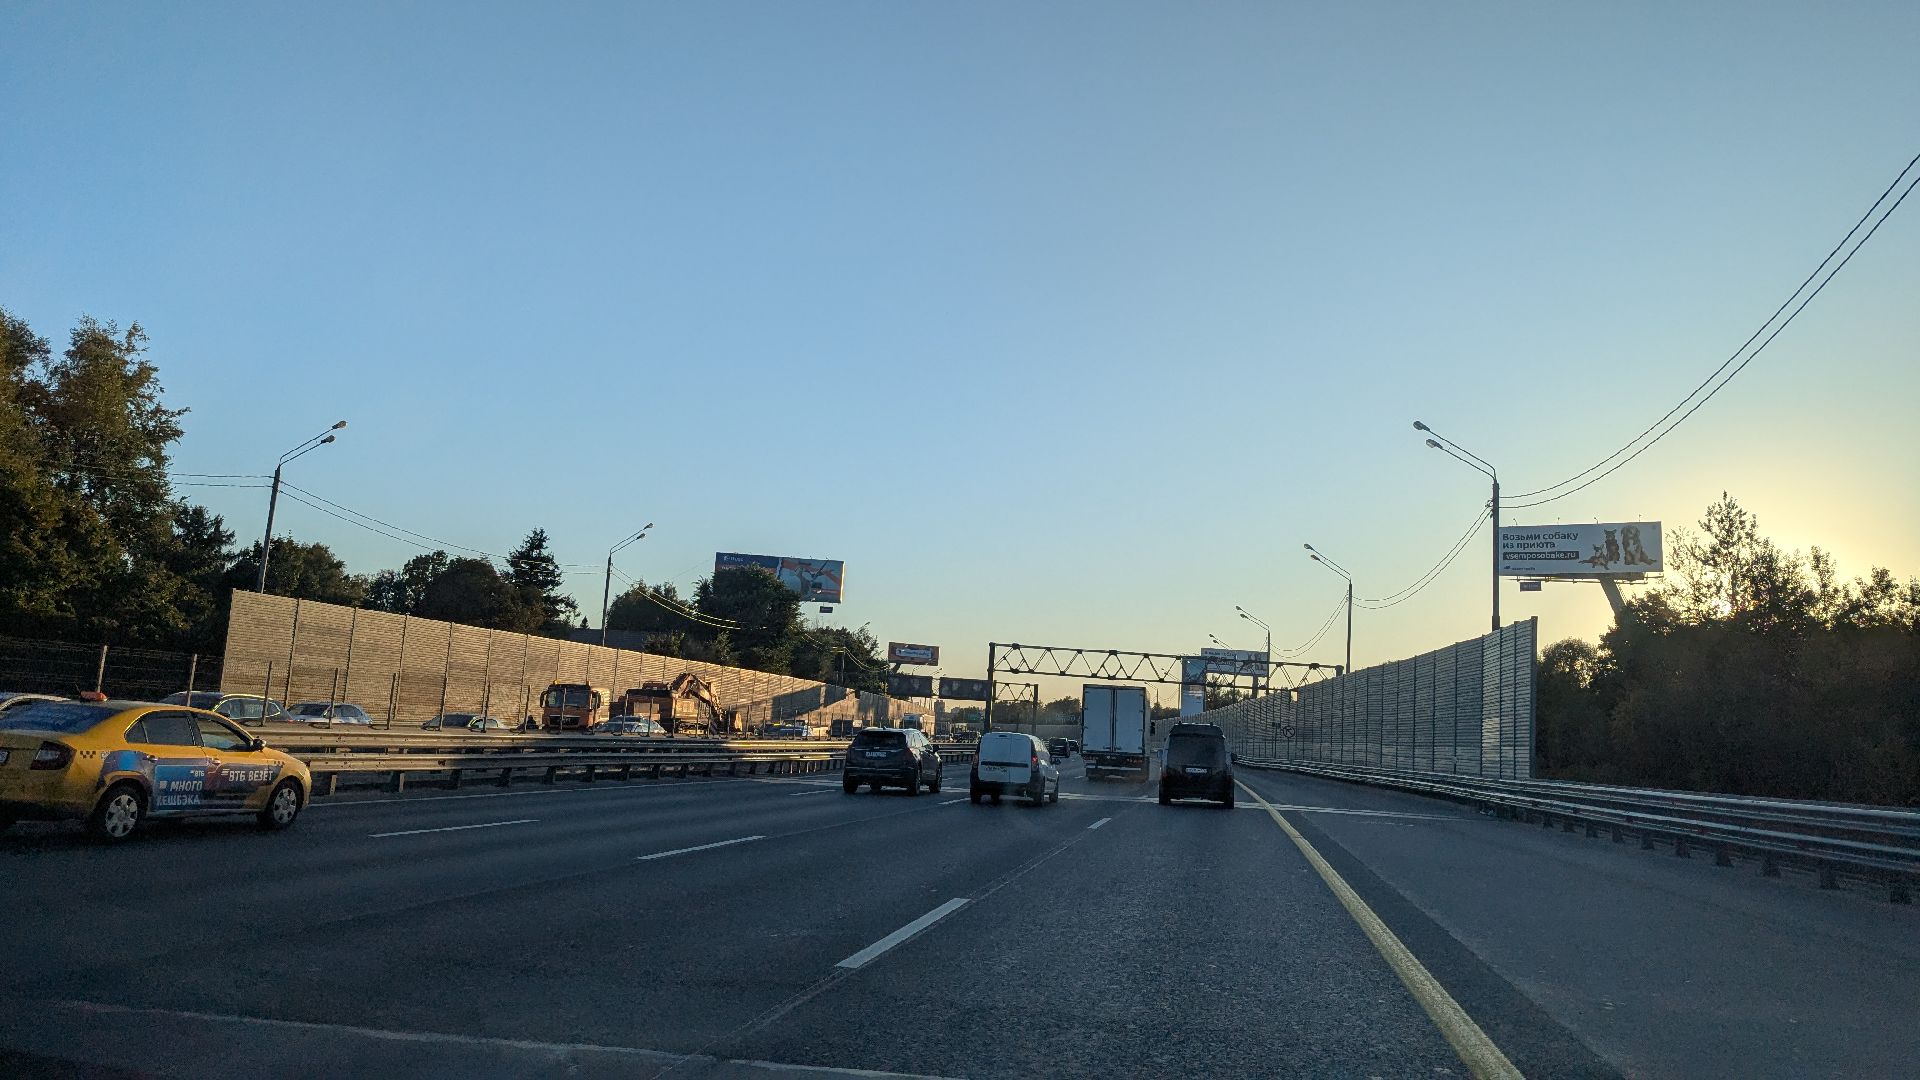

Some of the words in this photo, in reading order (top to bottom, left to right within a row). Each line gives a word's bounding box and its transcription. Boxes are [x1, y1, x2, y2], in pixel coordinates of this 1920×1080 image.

[1503, 533, 1540, 541] Возьми
[1542, 532, 1578, 541] собаку
[1517, 541, 1555, 550] приюта
[1506, 552, 1576, 560] vsemposobake.ru
[229, 770, 246, 782] ВТБ
[170, 780, 203, 792] МНОГО
